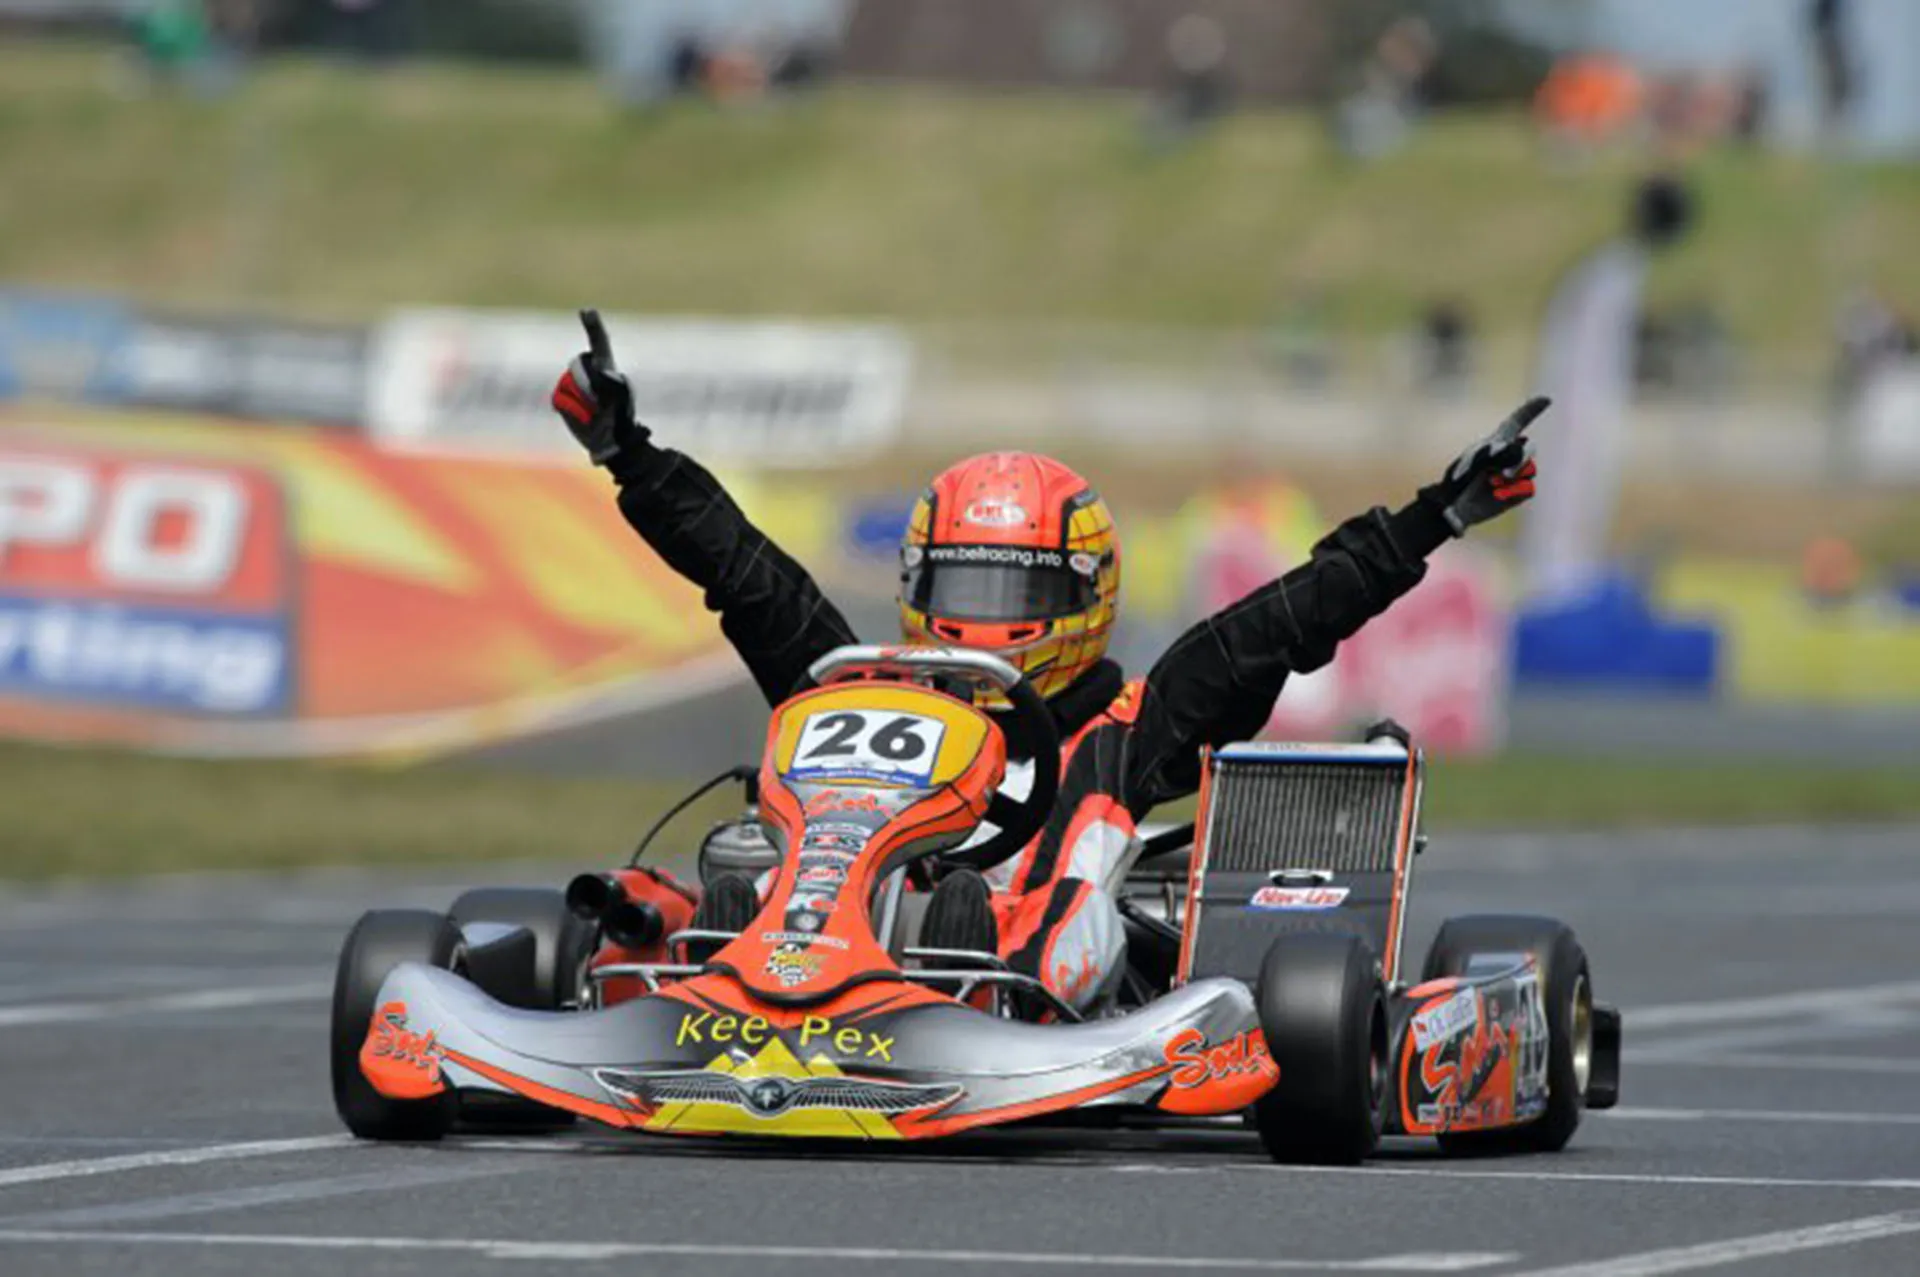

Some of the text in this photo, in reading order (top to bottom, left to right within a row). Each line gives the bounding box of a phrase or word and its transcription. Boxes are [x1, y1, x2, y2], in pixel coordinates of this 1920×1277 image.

[928, 545, 1063, 567] www.bellracing.info
[801, 711, 926, 761] 26
[675, 1011, 896, 1063] Kee Pex
